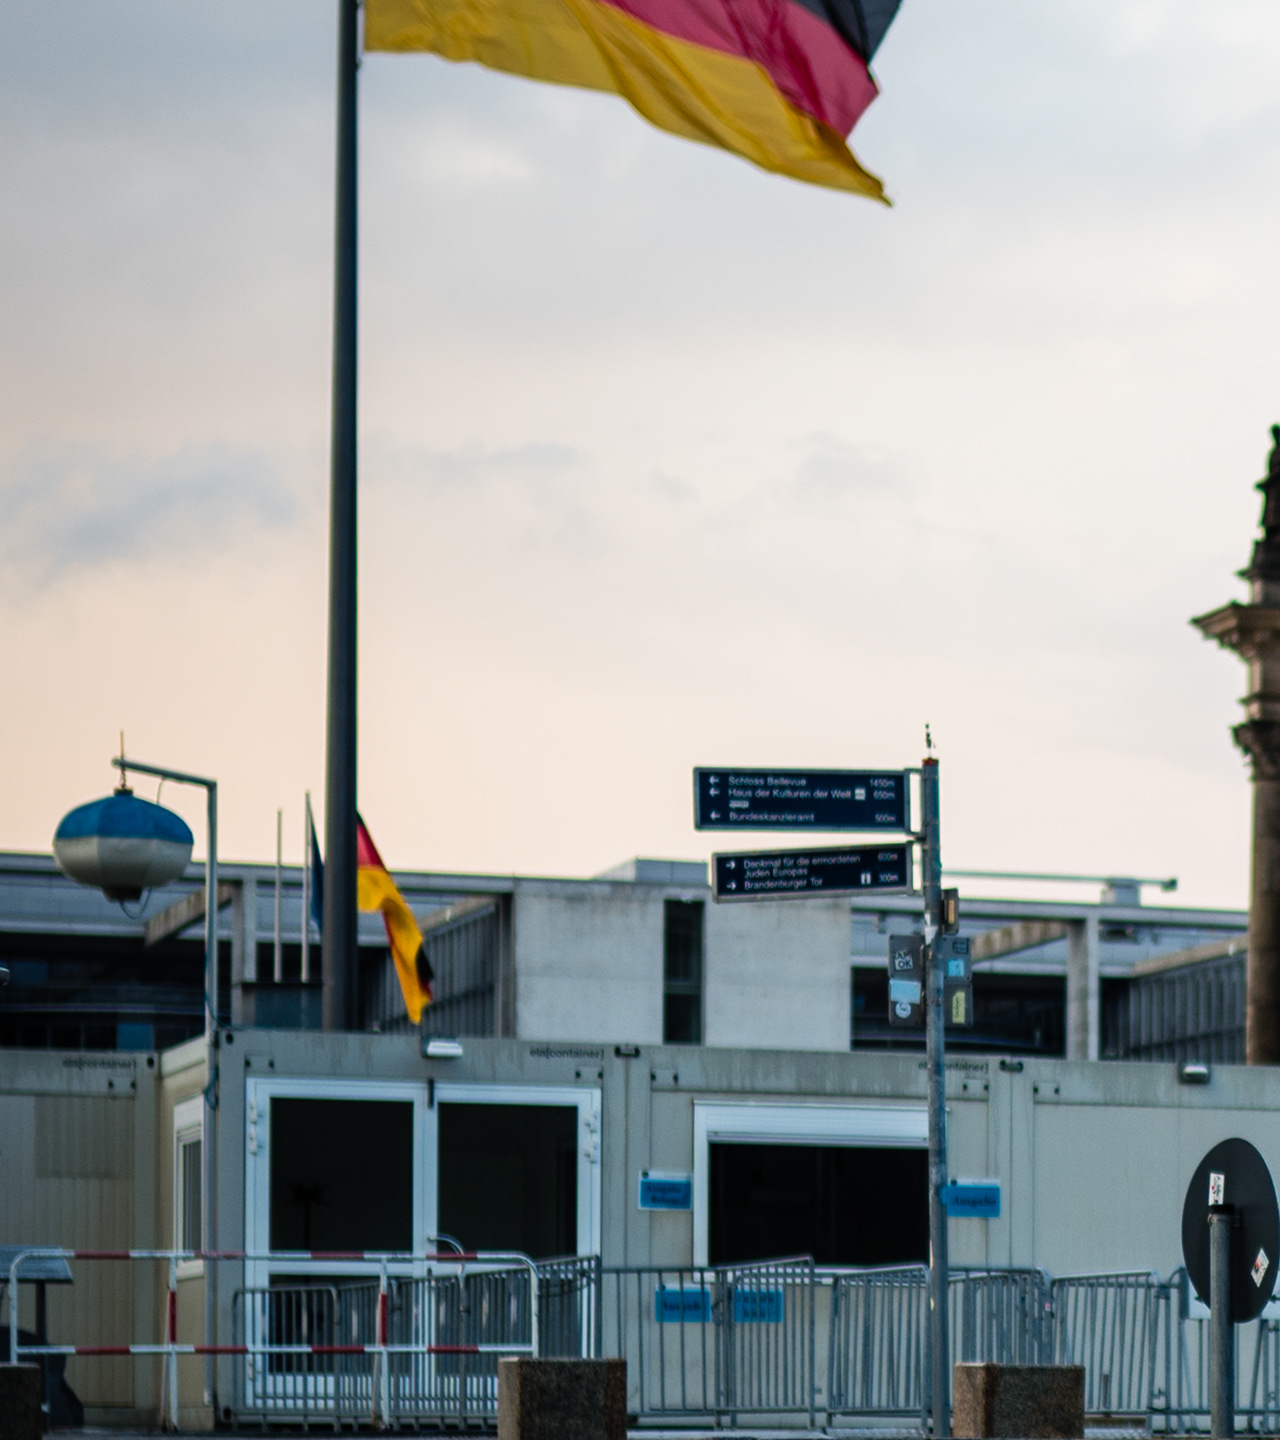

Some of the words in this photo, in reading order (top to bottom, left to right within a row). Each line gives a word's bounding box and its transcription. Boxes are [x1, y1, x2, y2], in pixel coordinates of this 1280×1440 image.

[728, 776, 765, 786] Schloss
[767, 777, 807, 787] Bellevue
[728, 788, 753, 798] Haus
[755, 789, 770, 798] der
[772, 789, 811, 799] Kulturen
[813, 790, 828, 799] der
[729, 811, 815, 822] Bundeskanzleramt
[744, 858, 781, 869] Denkmal
[783, 857, 794, 867] für
[796, 856, 809, 866] die
[811, 854, 861, 865] ermordeten
[744, 868, 770, 878] Juden
[772, 867, 808, 878] Europas
[744, 878, 807, 891] Brandenburger
[810, 877, 823, 886] Tor
